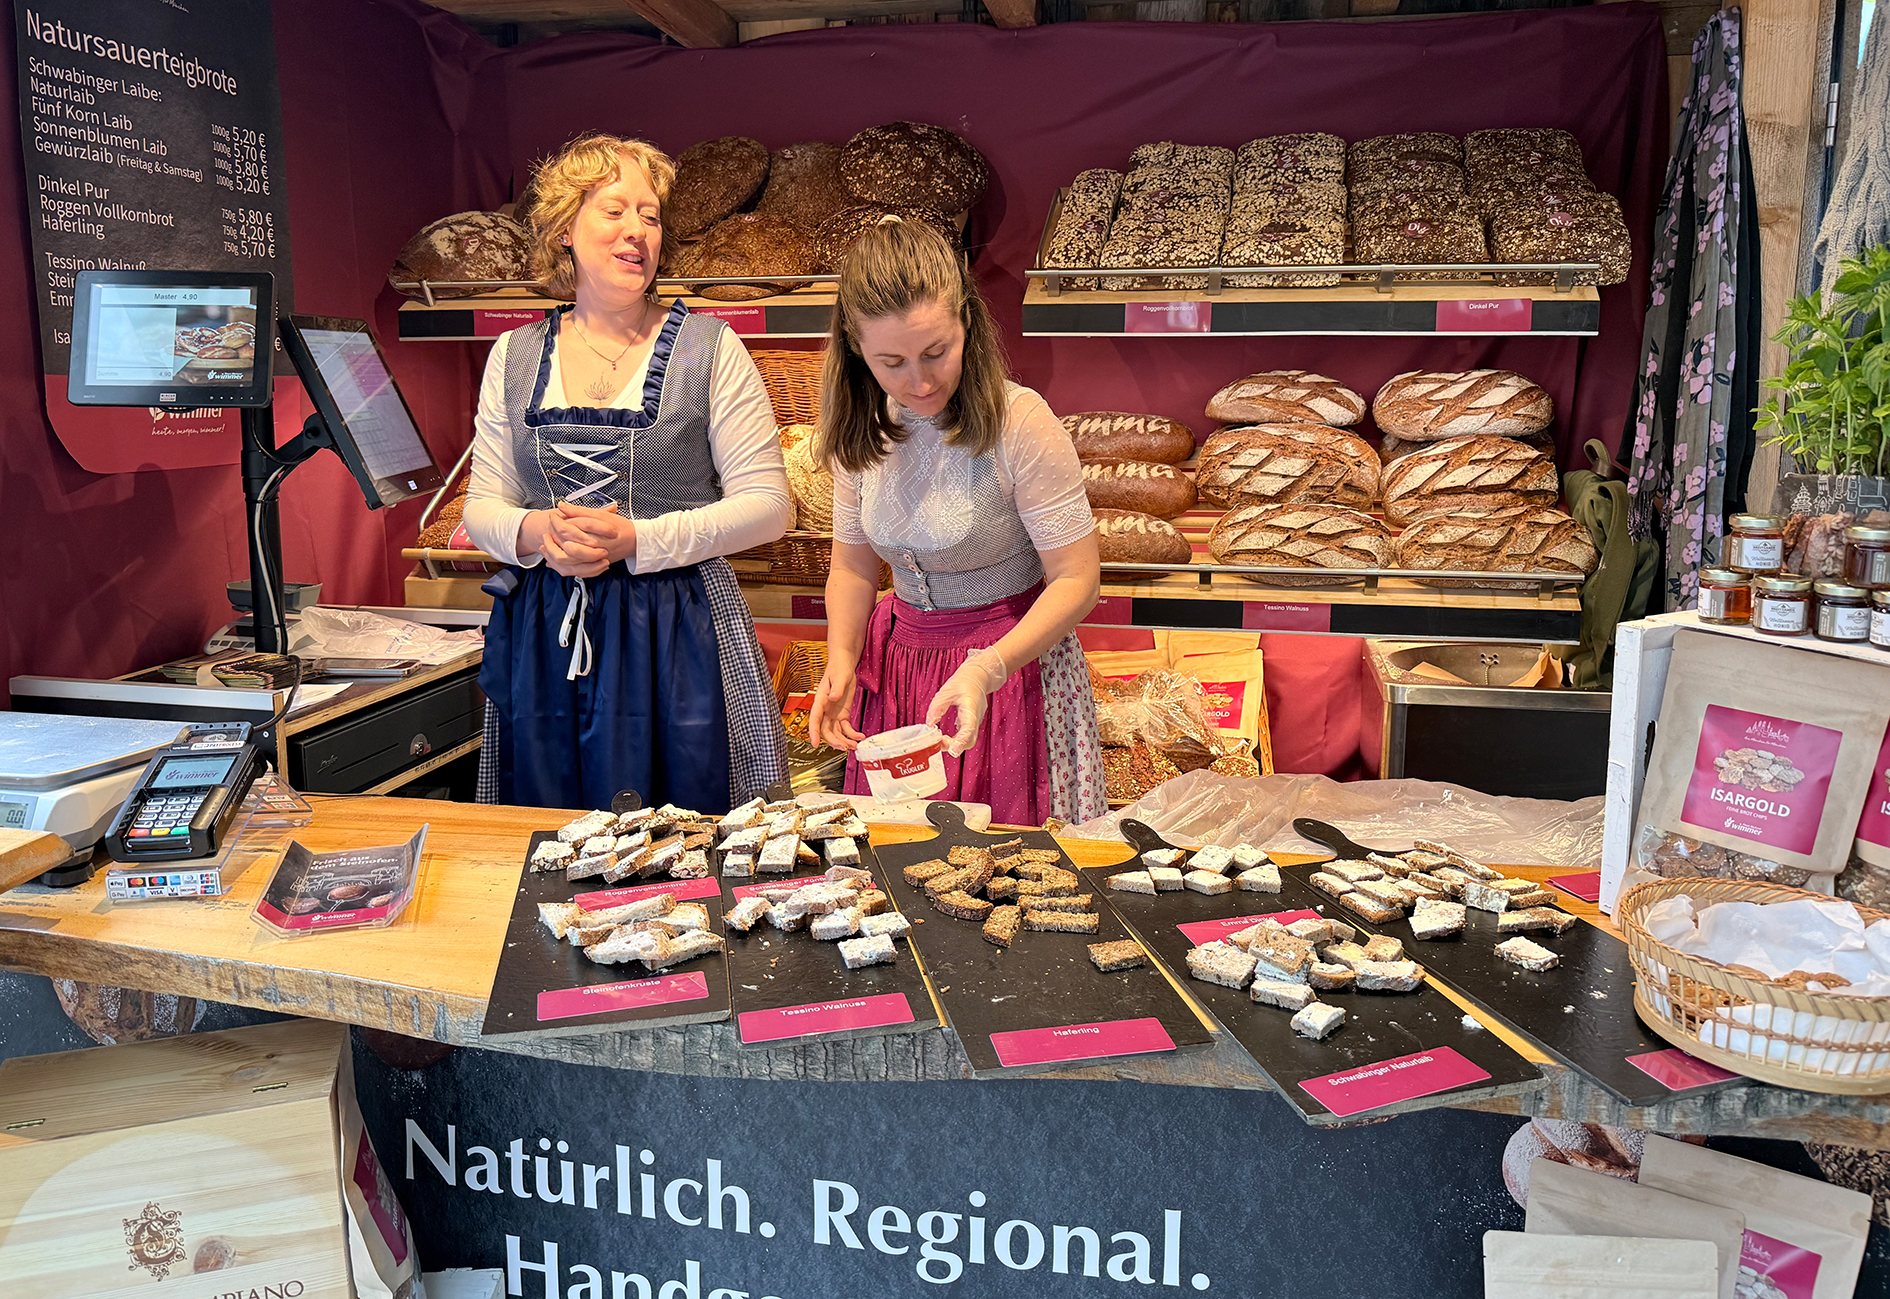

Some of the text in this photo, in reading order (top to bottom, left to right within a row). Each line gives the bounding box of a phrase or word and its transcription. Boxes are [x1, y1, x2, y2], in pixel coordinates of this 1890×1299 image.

[26, 9, 238, 96] Natursauerteigbrote
[29, 56, 162, 102] Schwabinger Laibe:
[30, 76, 96, 106] Naturlaib
[31, 96, 133, 131] Fünf Korn Laib
[33, 116, 168, 156] Sonnenblumen Laib
[211, 124, 266, 148] 1000g 5,20 €
[34, 136, 203, 183] Gewürzlaib (Freitag & Samstag)
[212, 140, 268, 164] 1000g 5,70 €
[214, 157, 269, 181] 1000g 5,80 €
[38, 174, 110, 200] Dinkel Pur
[215, 174, 271, 196] 1000g 5,20 €
[40, 194, 174, 228] Roggen Vollkornbrot
[221, 208, 273, 228] 750g 5,80 €
[42, 214, 105, 240] Haferling
[223, 224, 275, 245] 750g 4,20 €
[45, 252, 95, 270] Tessino
[223, 240, 276, 260] 750g 5,70 €
[182, 293, 198, 301] 4,90
[1143, 305, 1194, 313] Roggenvollkornbrot
[54, 329, 71, 344] Isa
[1710, 787, 1790, 817] ISARGOLD
[1726, 806, 1768, 820] FEINE BROT CHIPS
[1731, 822, 1762, 836] wimmer
[310, 863, 336, 871] dem
[312, 857, 346, 866] Frisch
[604, 881, 688, 897] Roggenvollkornbrot
[749, 879, 803, 892] Schwabinger
[582, 979, 661, 995] Steinofenkruste
[780, 1000, 867, 1017] Tessino Walnuss
[1053, 1026, 1100, 1037] Haferling
[1328, 1055, 1434, 1087] Schwabinger Naturlaib
[404, 1118, 1211, 1291] Natürlich. Regional.
[506, 1234, 785, 1299] Hand
